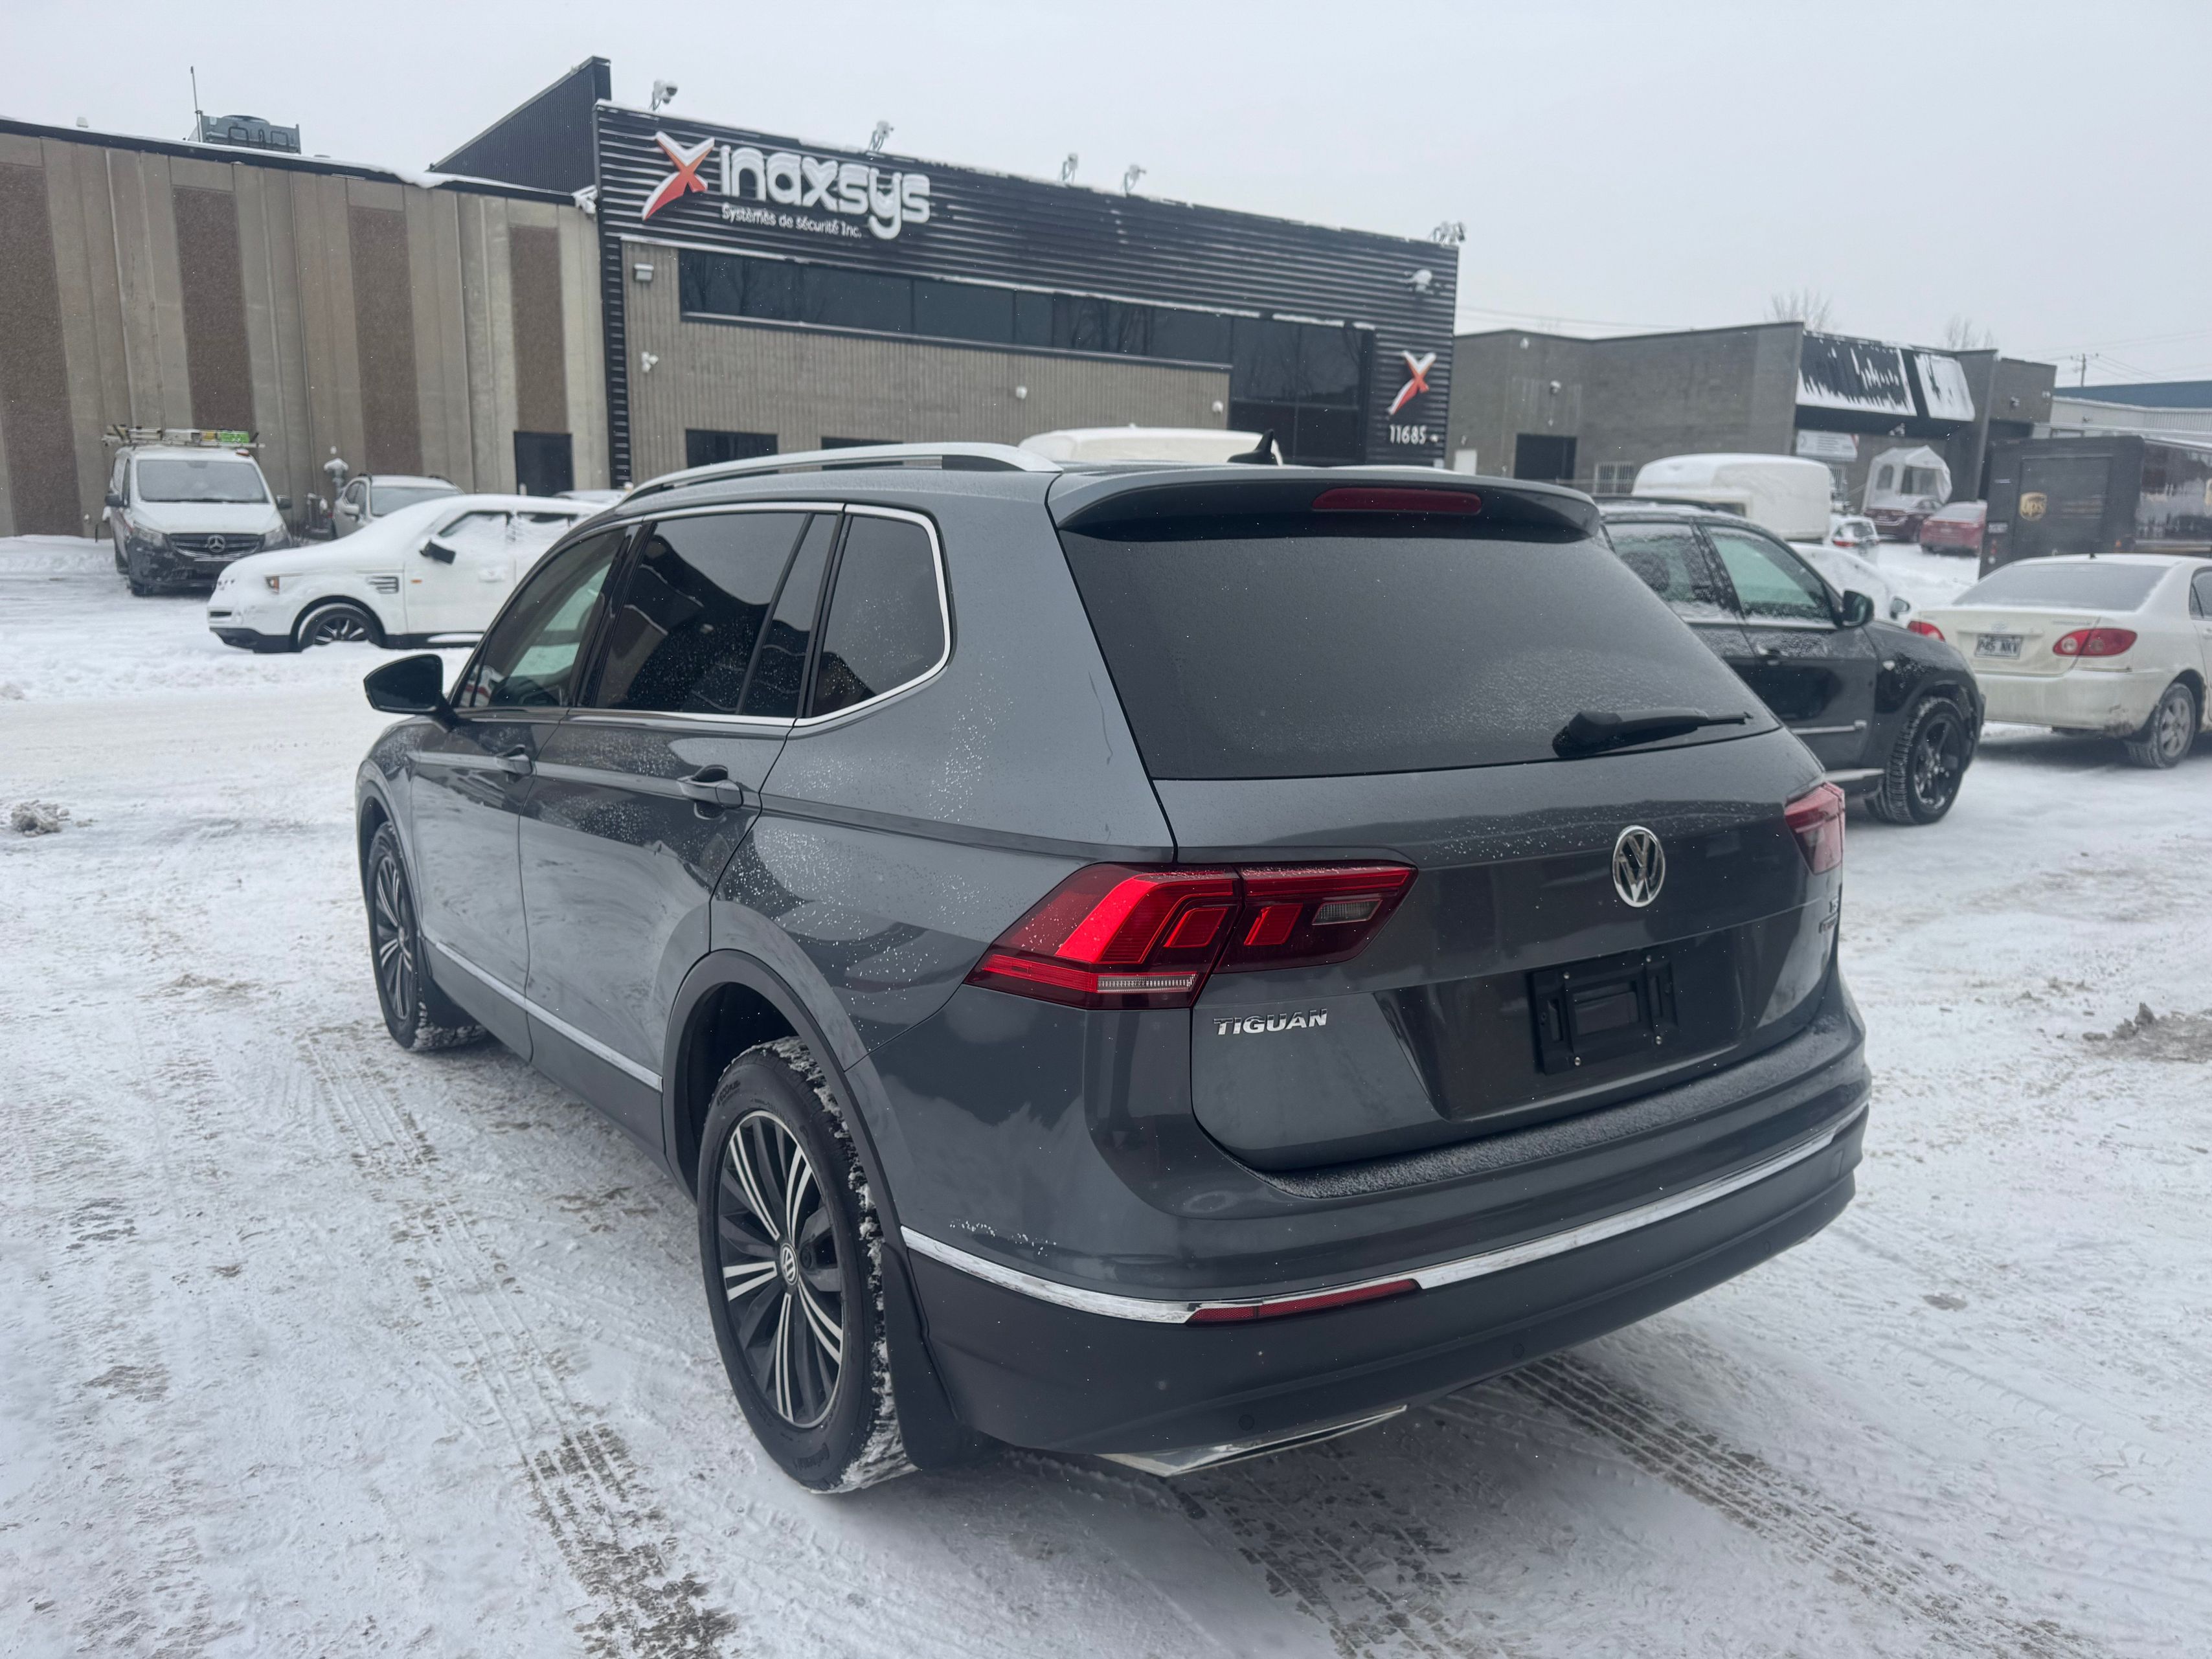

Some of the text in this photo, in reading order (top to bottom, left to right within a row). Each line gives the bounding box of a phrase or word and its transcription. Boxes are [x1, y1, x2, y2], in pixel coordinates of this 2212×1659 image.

[720, 144, 931, 240] inaxsys
[721, 202, 777, 227] Systèmes
[778, 213, 794, 229] de
[1389, 424, 1427, 445] 11685
[1213, 1008, 1327, 1035] TIGUAN
